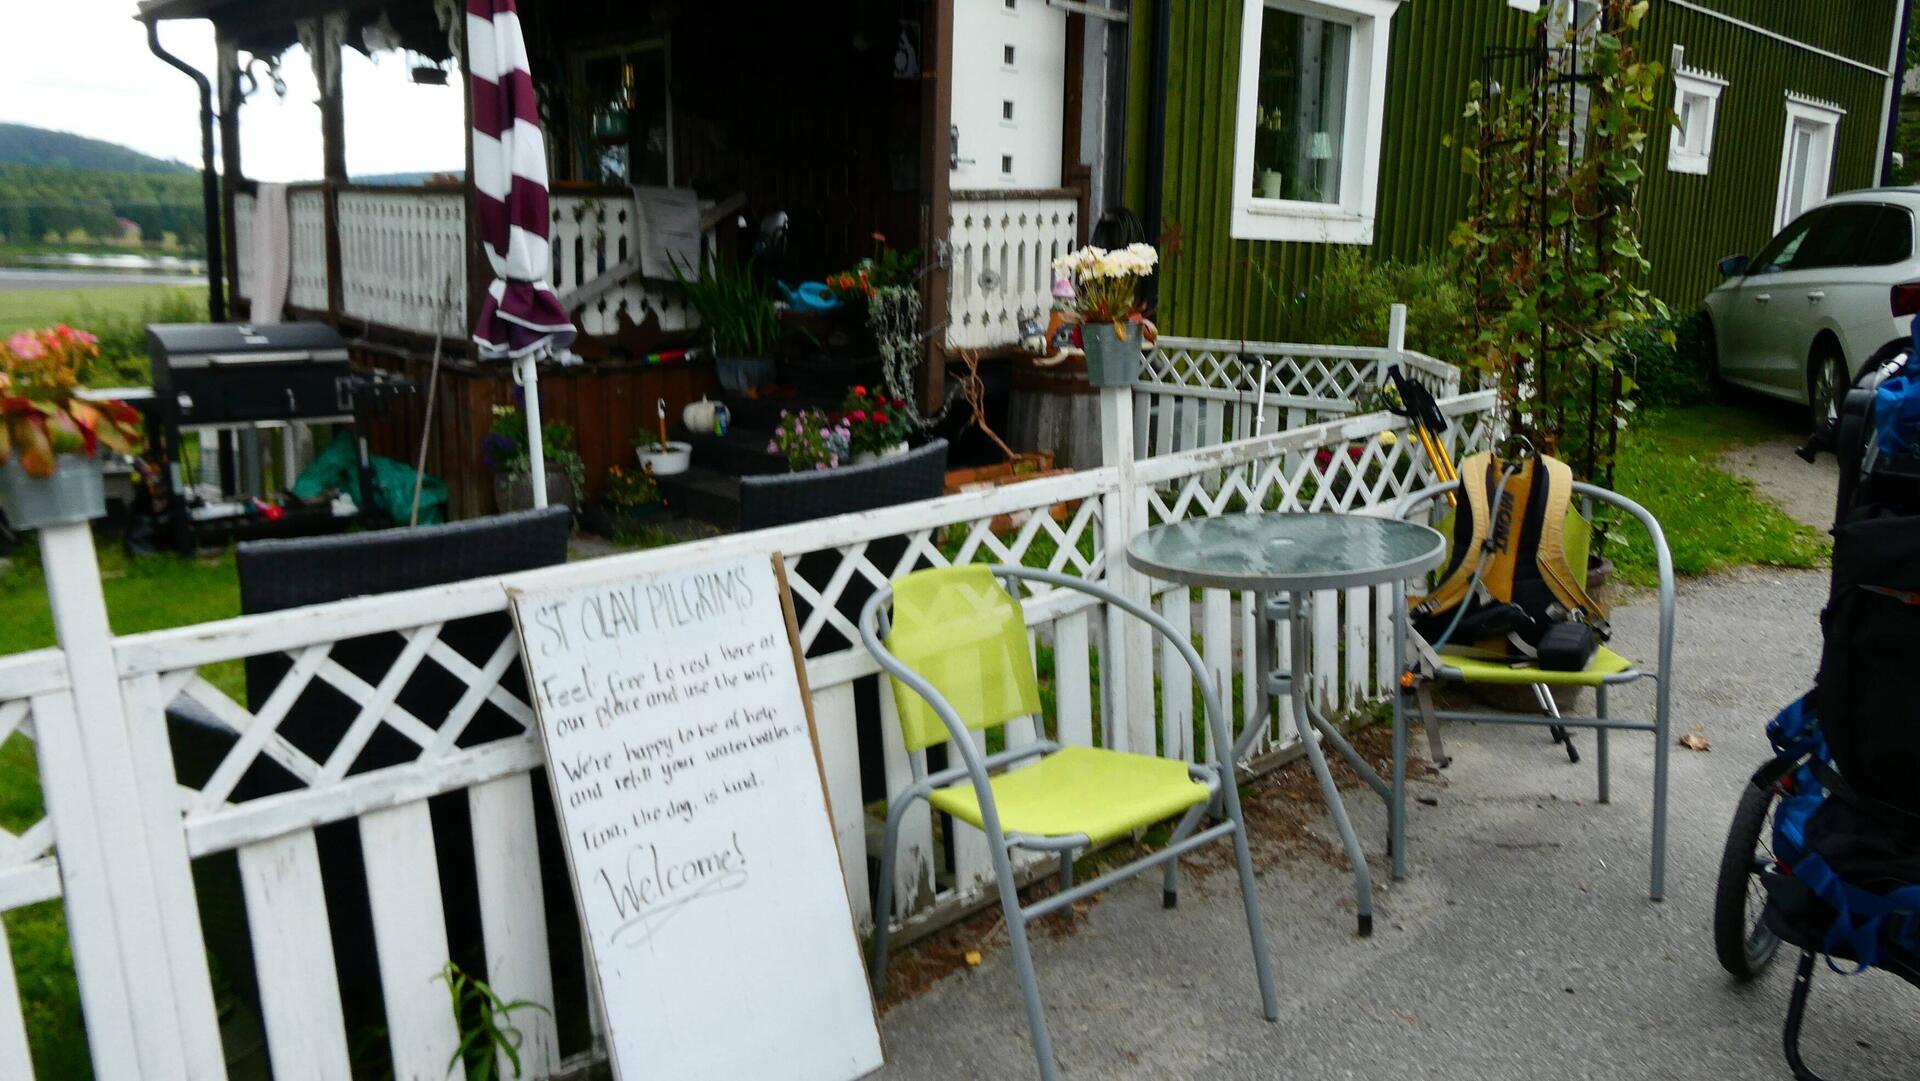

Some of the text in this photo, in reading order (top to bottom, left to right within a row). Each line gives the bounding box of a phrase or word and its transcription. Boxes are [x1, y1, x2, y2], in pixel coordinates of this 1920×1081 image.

[535, 564, 755, 658] ST OLAV PILGRIMS
[542, 633, 776, 710] Feel free to rest here at
[556, 661, 774, 738] our place and use the wifi
[560, 705, 777, 783] We're happy to be of help
[569, 781, 604, 809] and
[614, 766, 652, 791] refill
[660, 756, 695, 786] your
[632, 808, 662, 829] the
[703, 790, 719, 805] is
[593, 830, 748, 920] Welcome!
